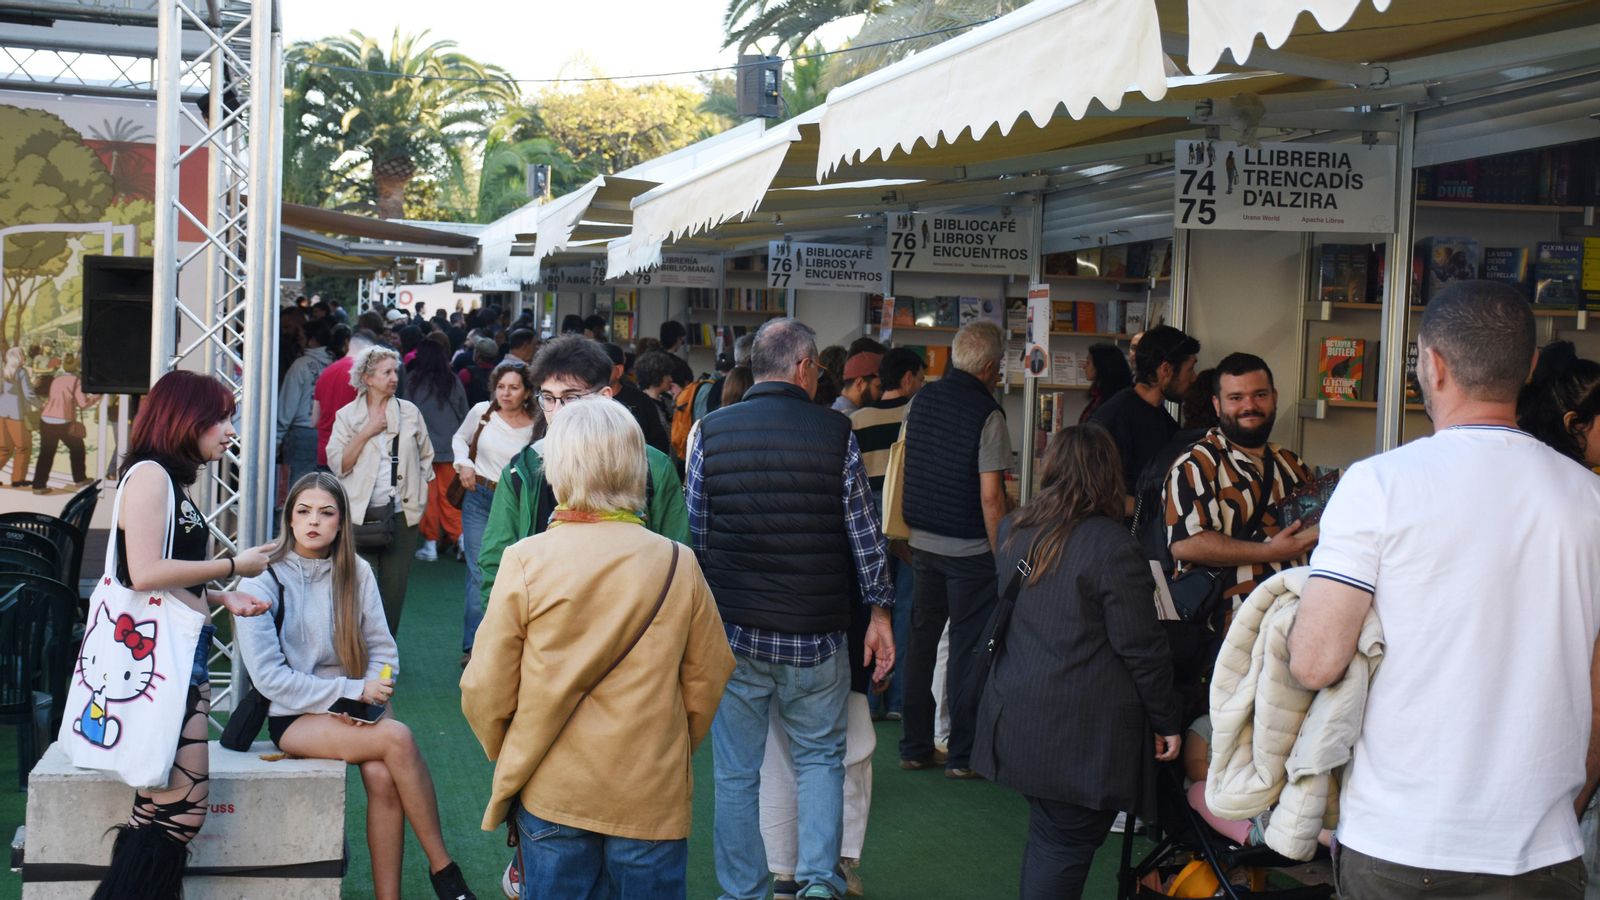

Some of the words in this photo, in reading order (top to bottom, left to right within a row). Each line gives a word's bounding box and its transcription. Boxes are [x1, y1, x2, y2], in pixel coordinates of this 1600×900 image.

[1244, 148, 1352, 169] LLIBRERIA
[1180, 169, 1216, 196] 74
[1243, 168, 1364, 190] TRENCADÍS
[1438, 185, 1474, 198] DUNE
[1243, 190, 1338, 210] D'ALZIRA
[1179, 198, 1216, 225] 75
[1262, 214, 1280, 222] World
[934, 218, 1017, 233] BIBLIOCAFÉ
[1302, 216, 1324, 224] Apache
[891, 232, 917, 250] 76
[933, 232, 984, 245] LIBROS
[987, 235, 997, 245] Y
[806, 247, 873, 260] BIBLIOCAFÉ
[933, 246, 1029, 260] ENCUENTROS
[771, 258, 792, 272] 76
[805, 258, 847, 269] LIBROS
[849, 261, 857, 269] Y
[891, 251, 916, 269] 77
[592, 266, 606, 276] 78
[661, 264, 715, 273] BIBLIOMANÍA
[636, 274, 651, 285] 79
[771, 273, 792, 287] 77
[805, 269, 882, 282] ENCUENTROS
[1327, 347, 1356, 357] BUTLER
